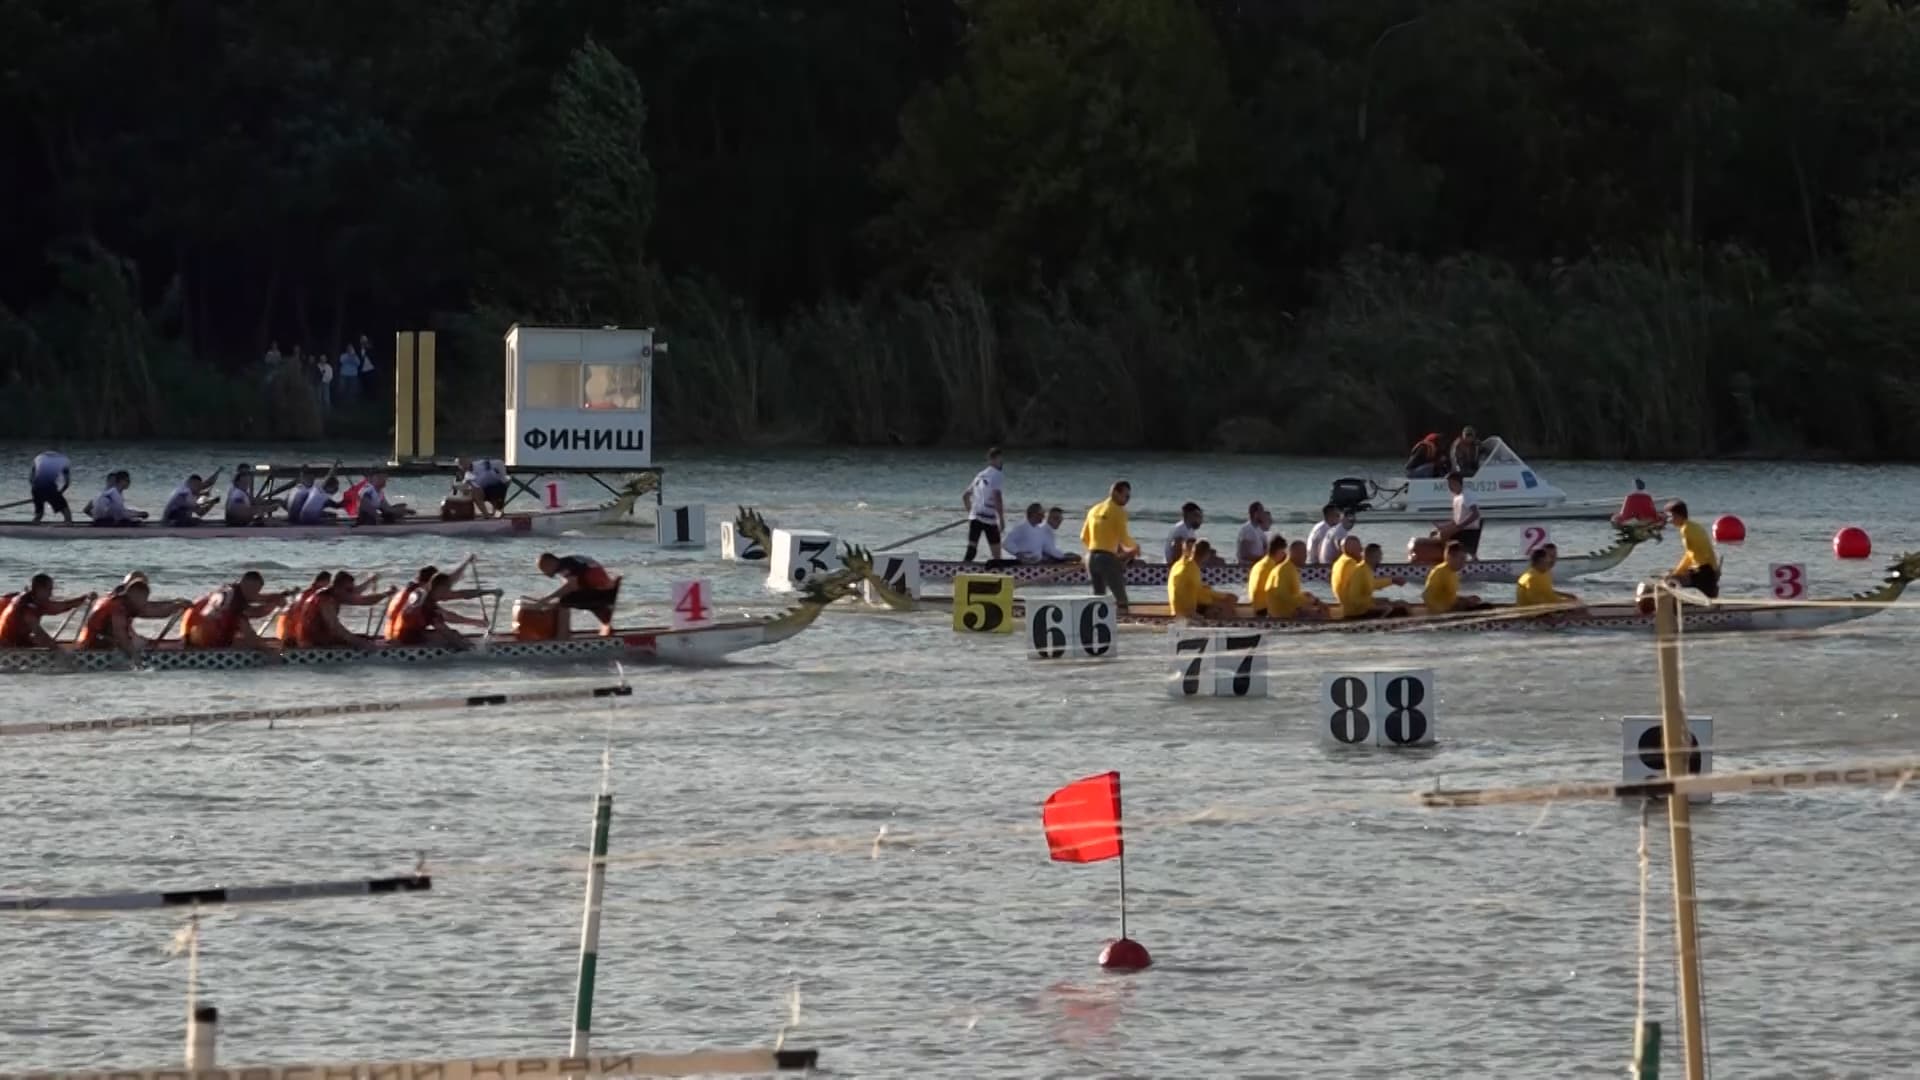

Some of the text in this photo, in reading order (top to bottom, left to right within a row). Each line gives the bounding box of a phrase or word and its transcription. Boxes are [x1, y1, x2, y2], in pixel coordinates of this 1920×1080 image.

[524, 428, 644, 452] ФИНИШ
[544, 483, 559, 509] 1
[672, 506, 694, 543] 1
[1524, 527, 1546, 557] 2
[794, 540, 831, 581] 3
[1774, 565, 1802, 600] 3
[675, 581, 708, 622] 4
[963, 580, 1004, 632] 5
